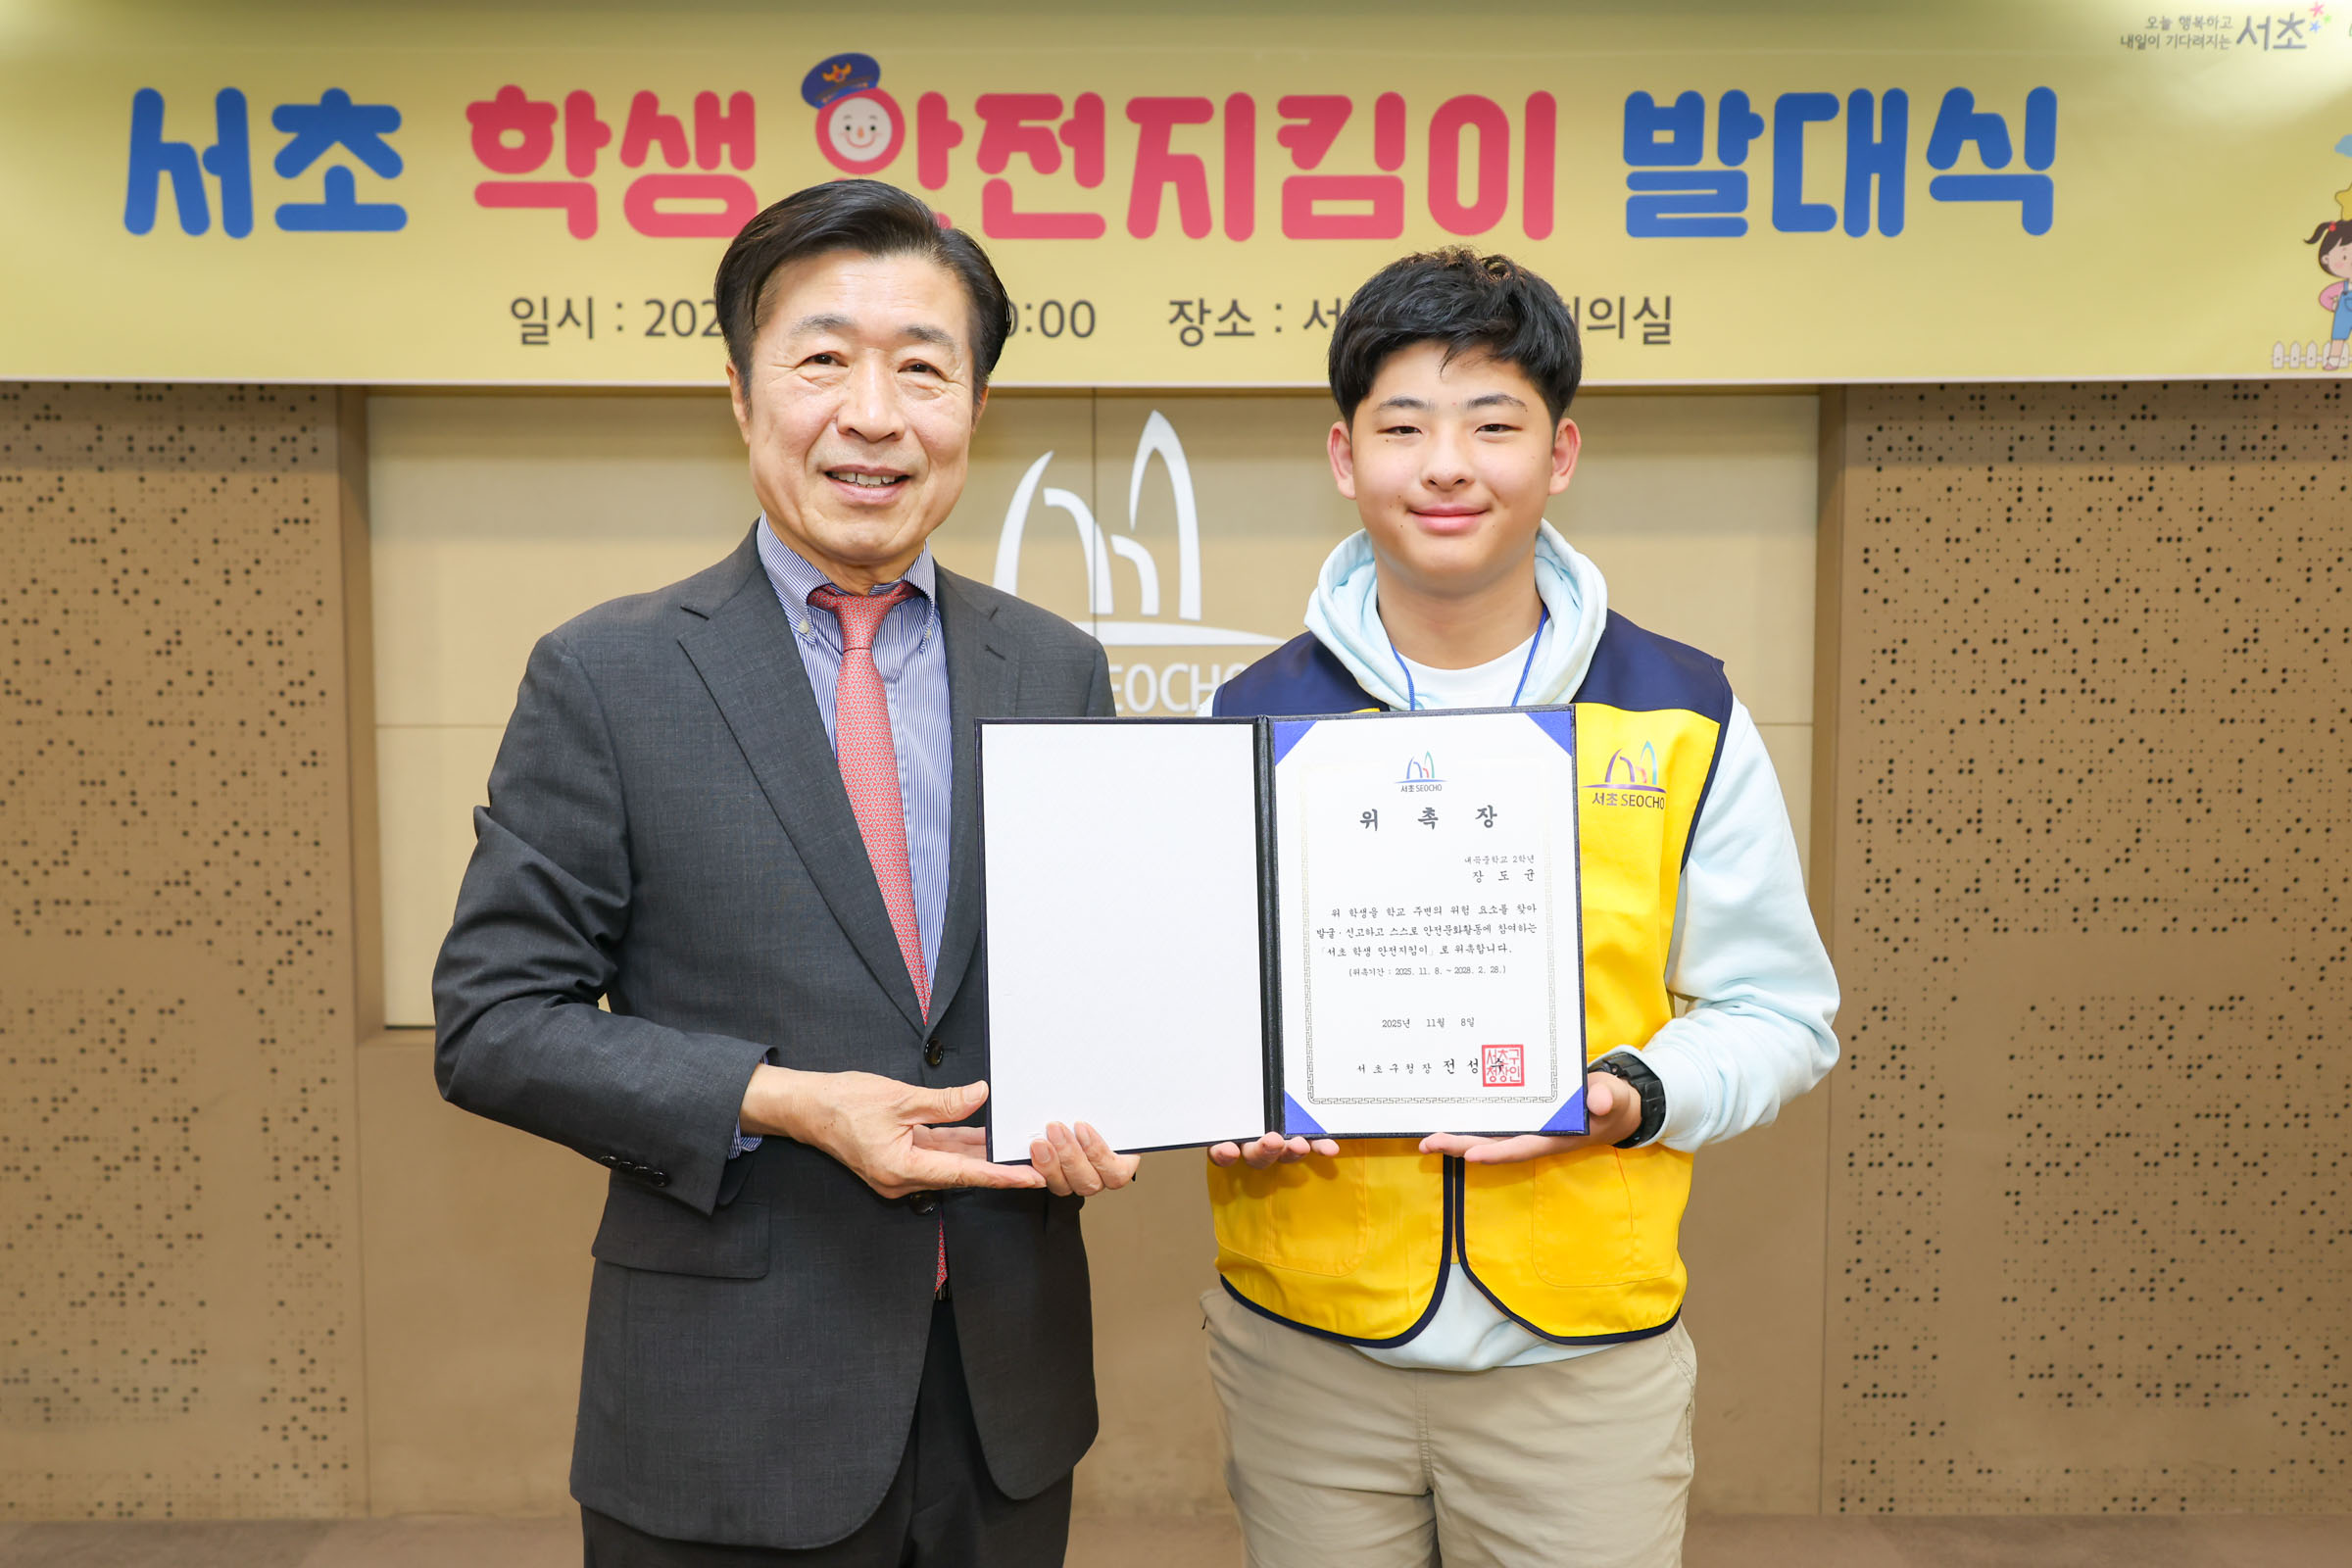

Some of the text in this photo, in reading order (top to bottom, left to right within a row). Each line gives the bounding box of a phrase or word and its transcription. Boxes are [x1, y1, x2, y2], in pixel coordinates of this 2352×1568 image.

[2146, 15, 2234, 30] 오늘 행복하고
[2236, 12, 2307, 51] 서초
[2121, 33, 2233, 50] 내일이 기다려지는
[124, 84, 2059, 242] 서초 학생 안전지킴이 발대식
[511, 296, 594, 345] 일시
[1168, 298, 1255, 347] 장소
[1400, 784, 1443, 793] 서초 SEOCHO
[1592, 792, 1665, 809] 서초 SEOCHO
[1359, 805, 1497, 831] 위 촉 장
[1332, 904, 1538, 919] 위 학생을 학교 주변의 위험 요소를 찾아
[1390, 926, 1418, 936] 스스로
[1423, 923, 1492, 937] 안전문화활동에
[1498, 922, 1538, 935] 참여하는
[1352, 946, 1371, 957] 학생
[1454, 943, 1512, 956] 위촉합니다.
[1382, 1017, 1475, 1029] 2025년 11월 8일
